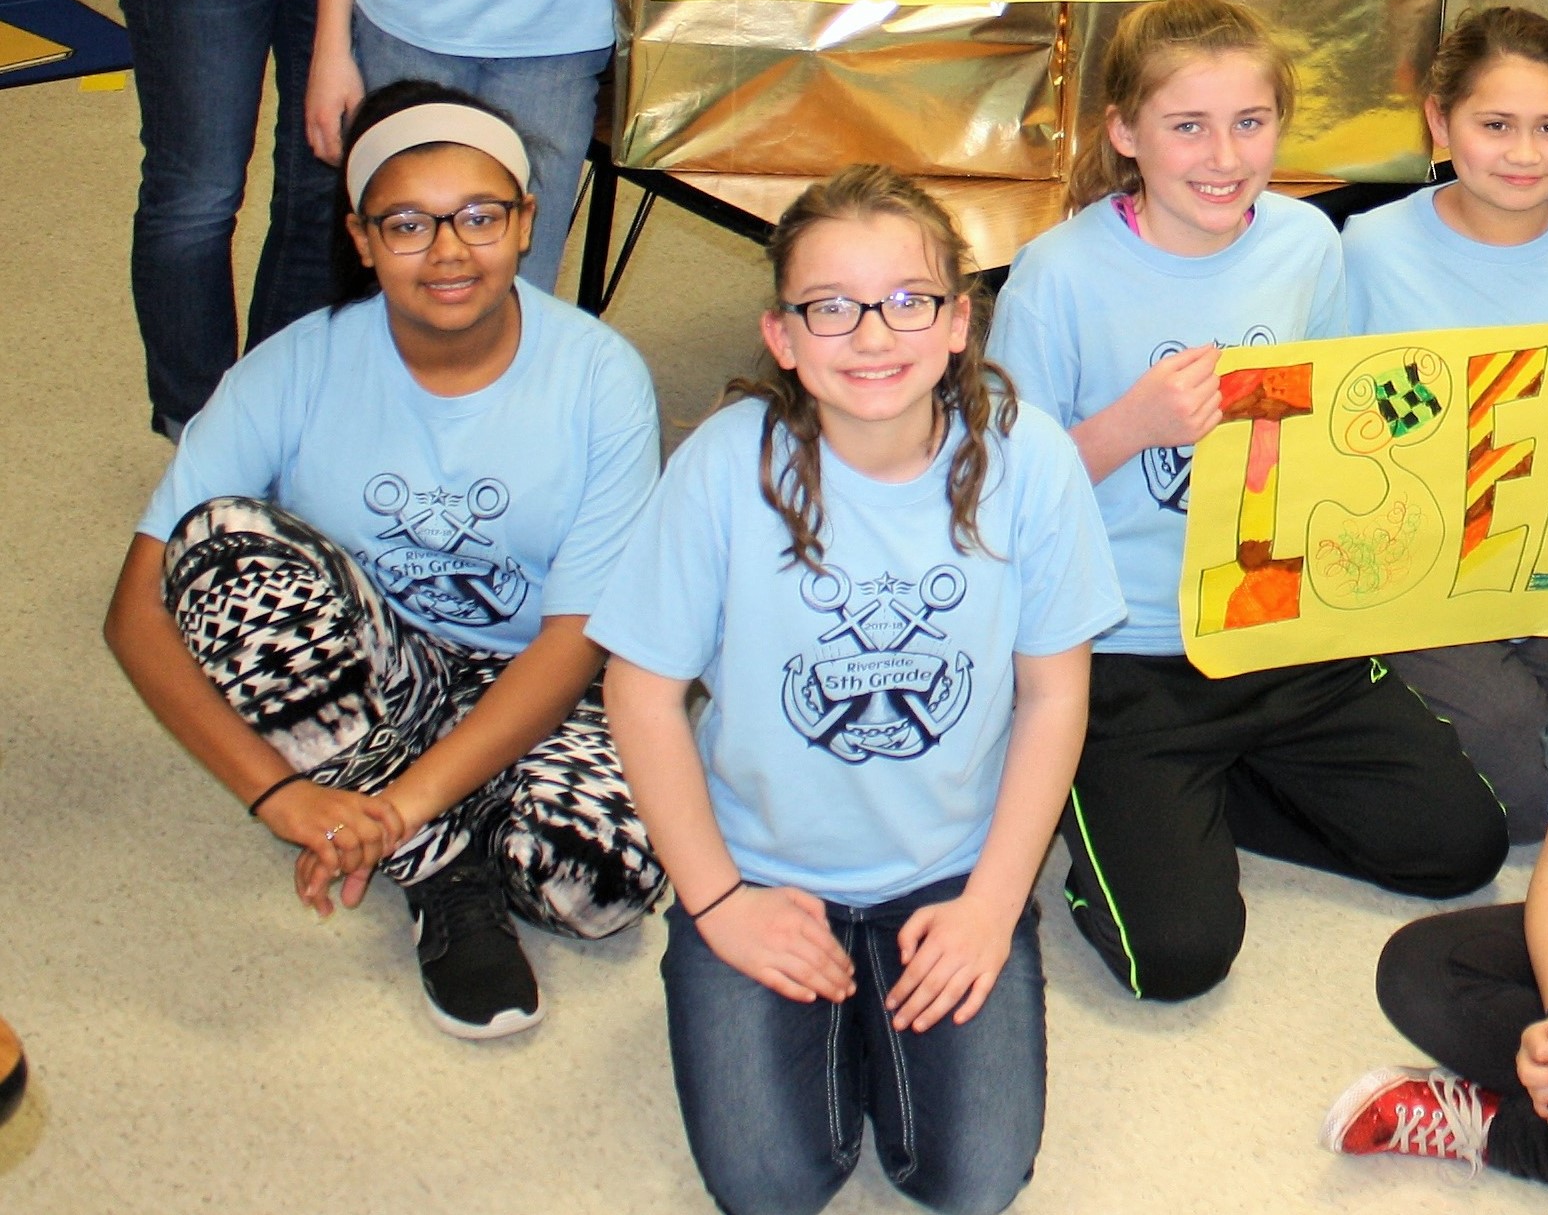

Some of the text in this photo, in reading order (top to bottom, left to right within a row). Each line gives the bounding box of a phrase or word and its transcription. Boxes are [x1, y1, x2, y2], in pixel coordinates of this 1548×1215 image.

[847, 657, 914, 673] Riverside
[825, 668, 932, 691] 5th Grade
